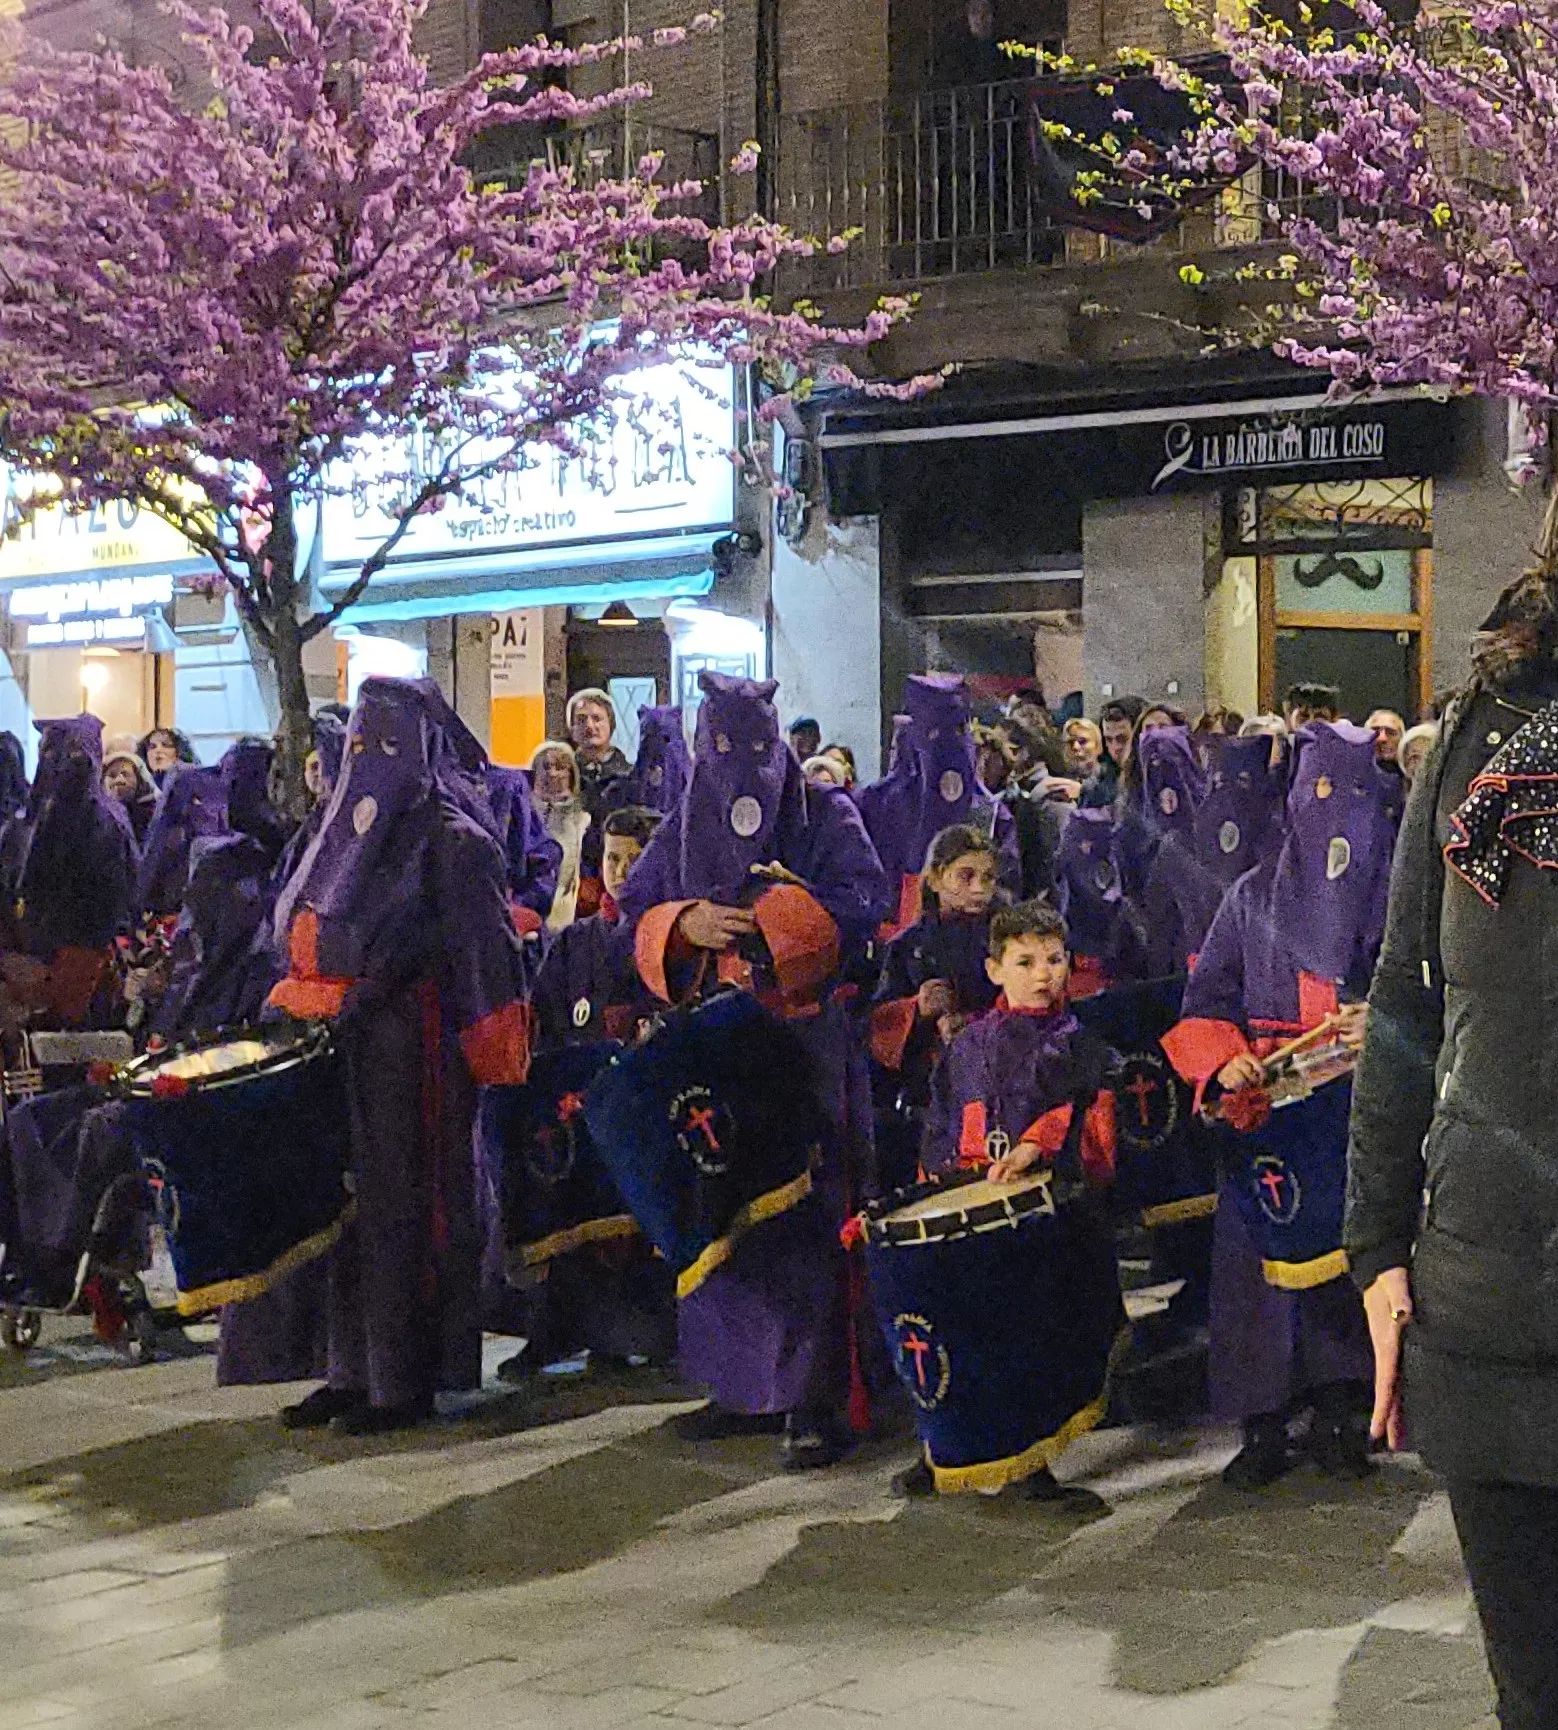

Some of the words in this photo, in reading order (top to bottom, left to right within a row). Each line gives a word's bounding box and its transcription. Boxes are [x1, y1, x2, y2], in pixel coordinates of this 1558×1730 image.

[1203, 435, 1220, 469] LA
[1309, 426, 1337, 459] DEL
[1343, 422, 1384, 457] COSO
